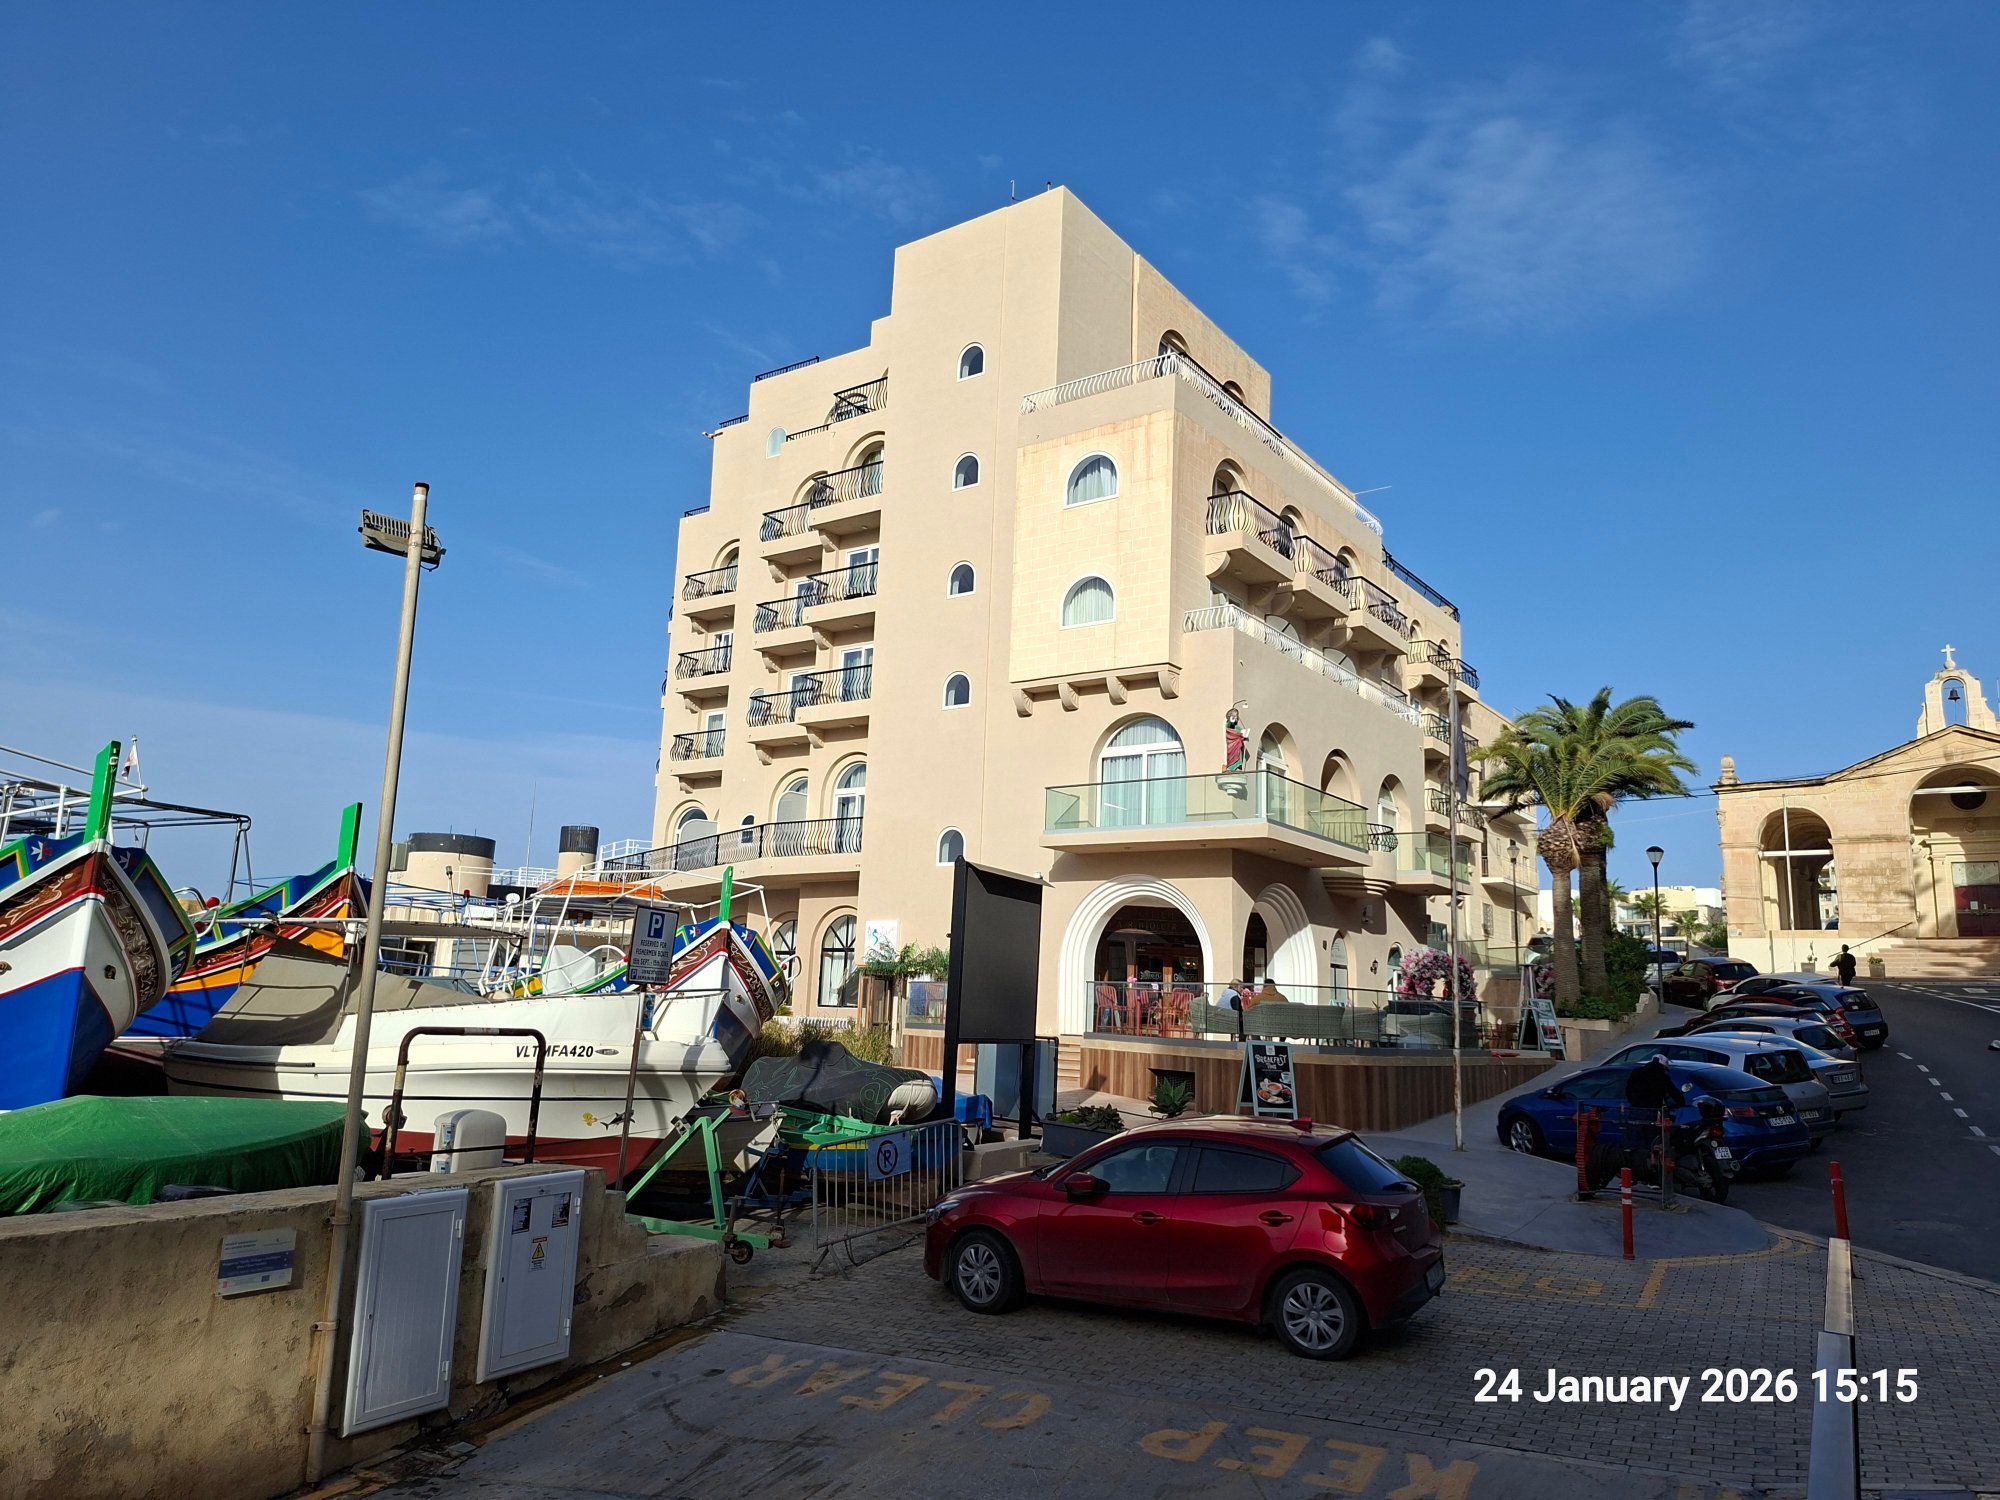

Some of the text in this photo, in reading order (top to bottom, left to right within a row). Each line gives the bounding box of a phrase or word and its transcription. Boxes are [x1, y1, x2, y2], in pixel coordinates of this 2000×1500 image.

[650, 914, 662, 937] P
[641, 939, 659, 947] RESERVED
[636, 948, 657, 957] FISHERMEN
[1255, 1055, 1287, 1066] BREAKFAST
[727, 1354, 1479, 1500] KEEP CLEAR
